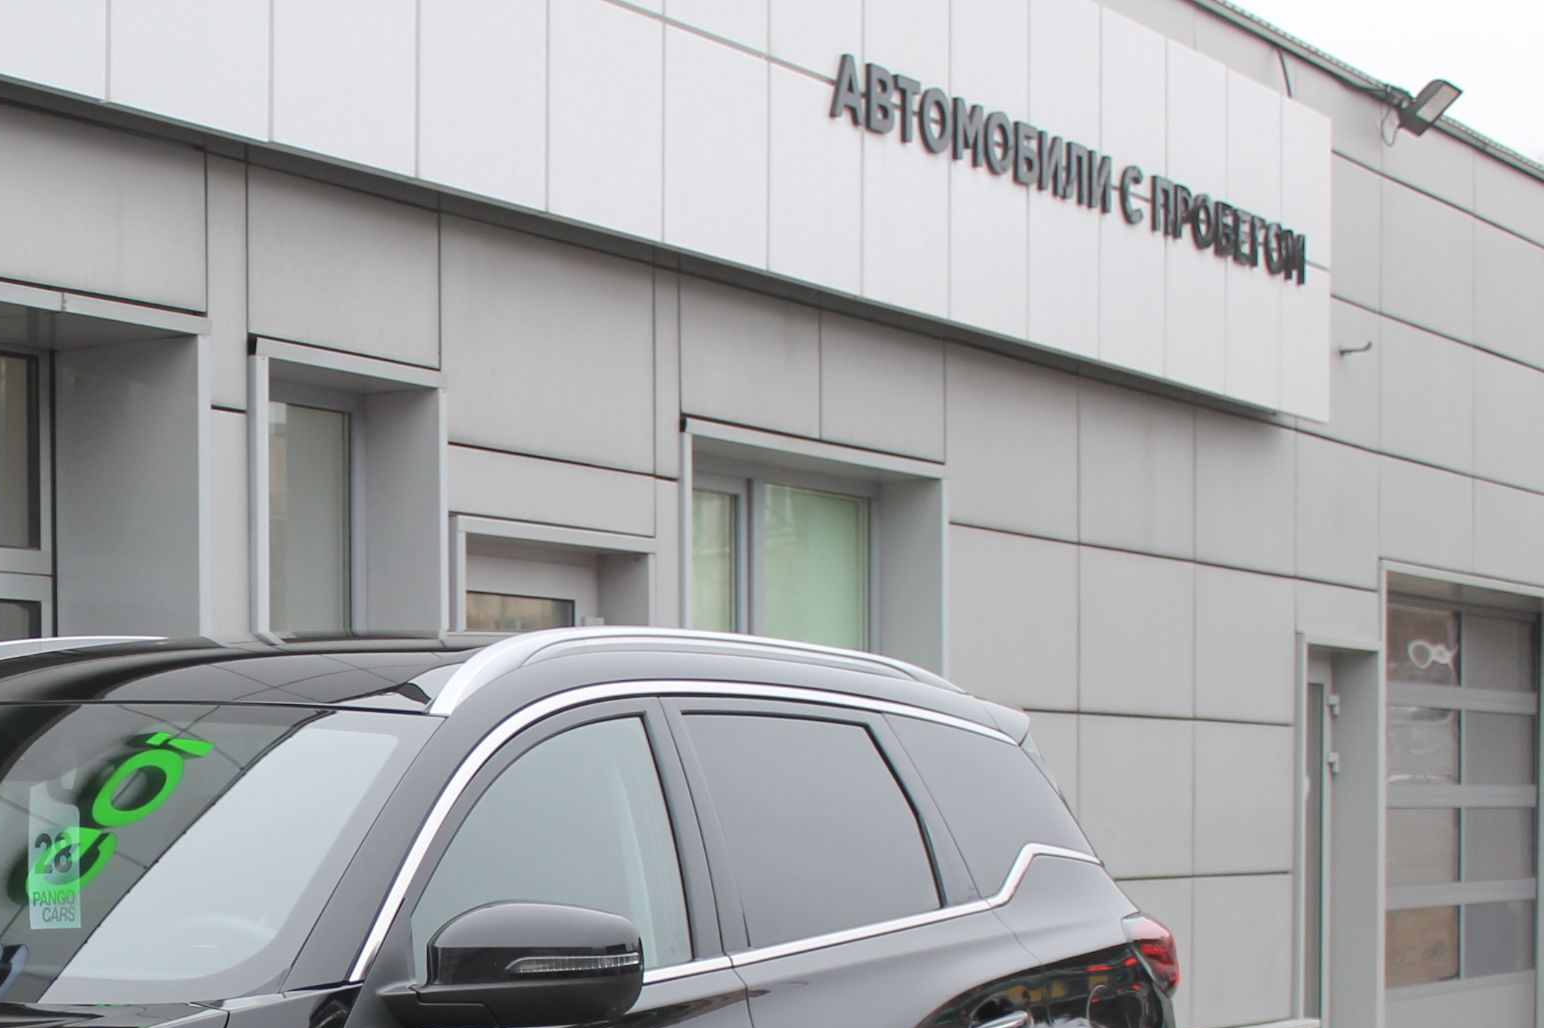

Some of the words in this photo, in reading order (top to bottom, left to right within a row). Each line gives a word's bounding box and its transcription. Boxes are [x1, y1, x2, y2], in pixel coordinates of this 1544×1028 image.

[829, 53, 1112, 214] АВТОМОБИЛИ
[1119, 165, 1144, 225] С
[1151, 174, 1306, 285] ПРОБЕГОМ
[32, 890, 76, 906] PANGO
[42, 906, 76, 922] CARS
